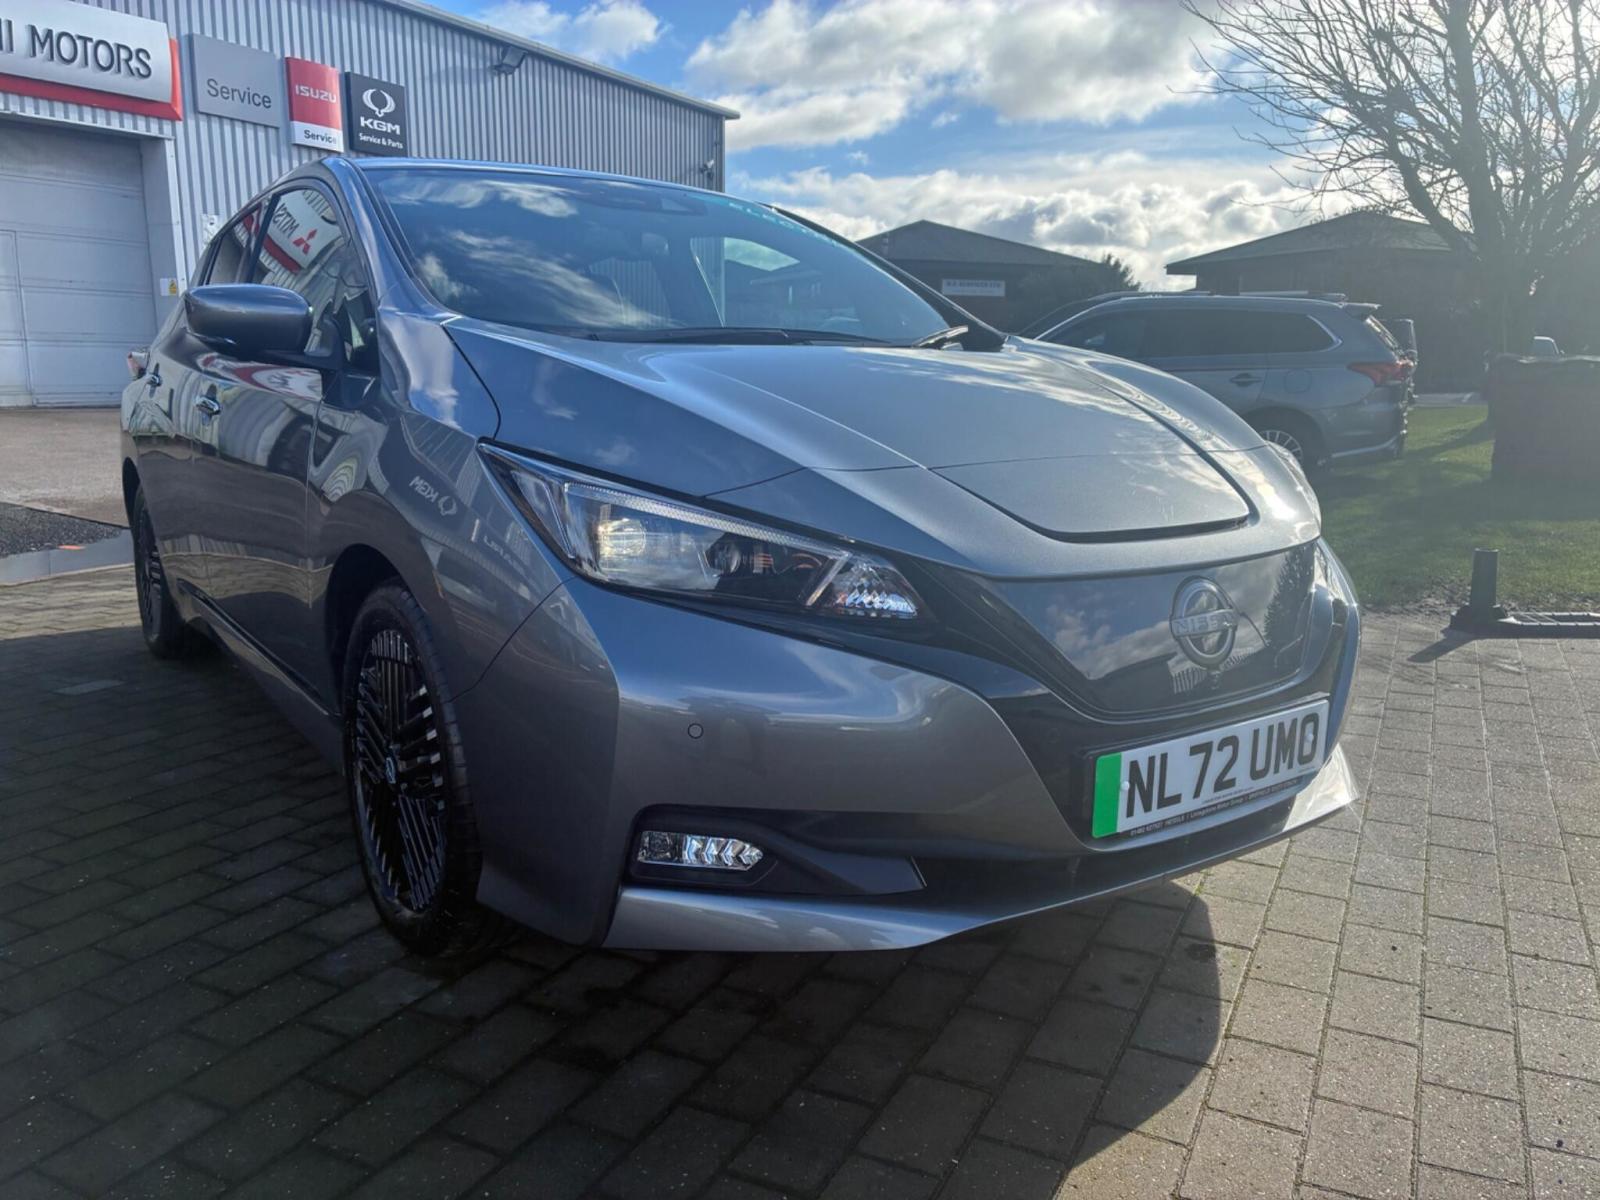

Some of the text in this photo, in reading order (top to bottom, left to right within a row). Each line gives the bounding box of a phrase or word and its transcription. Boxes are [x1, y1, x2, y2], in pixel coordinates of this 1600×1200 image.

[28, 24, 152, 79] MOTORS
[206, 78, 272, 109] Service
[295, 85, 336, 103] ISUZU
[360, 116, 400, 135] KGM
[359, 132, 380, 144] Service
[388, 139, 403, 149] Parts
[1126, 713, 1319, 817] NL72 UMO
